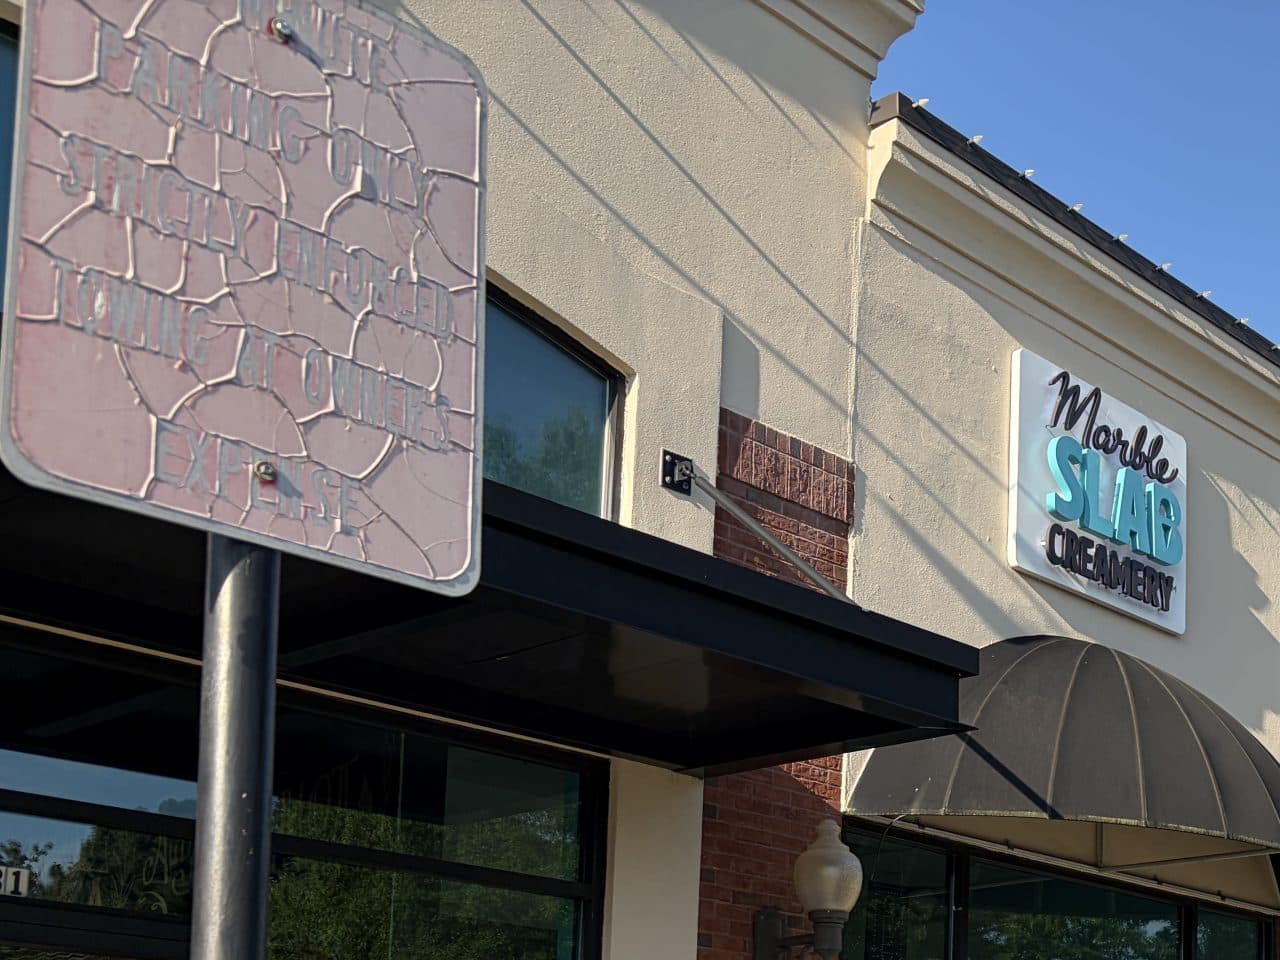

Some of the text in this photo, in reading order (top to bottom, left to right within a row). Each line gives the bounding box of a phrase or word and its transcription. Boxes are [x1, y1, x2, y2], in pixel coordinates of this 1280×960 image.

[99, 25, 430, 219] PARKING ONLY
[60, 134, 455, 340] STRICTLY ENFORCED
[56, 260, 209, 365] TOWING
[241, 332, 275, 392] AT
[156, 427, 361, 535] EXPENSE
[1048, 371, 1179, 484] Marble
[1046, 435, 1184, 567] SLAB
[1046, 523, 1176, 613] CREAMERY
